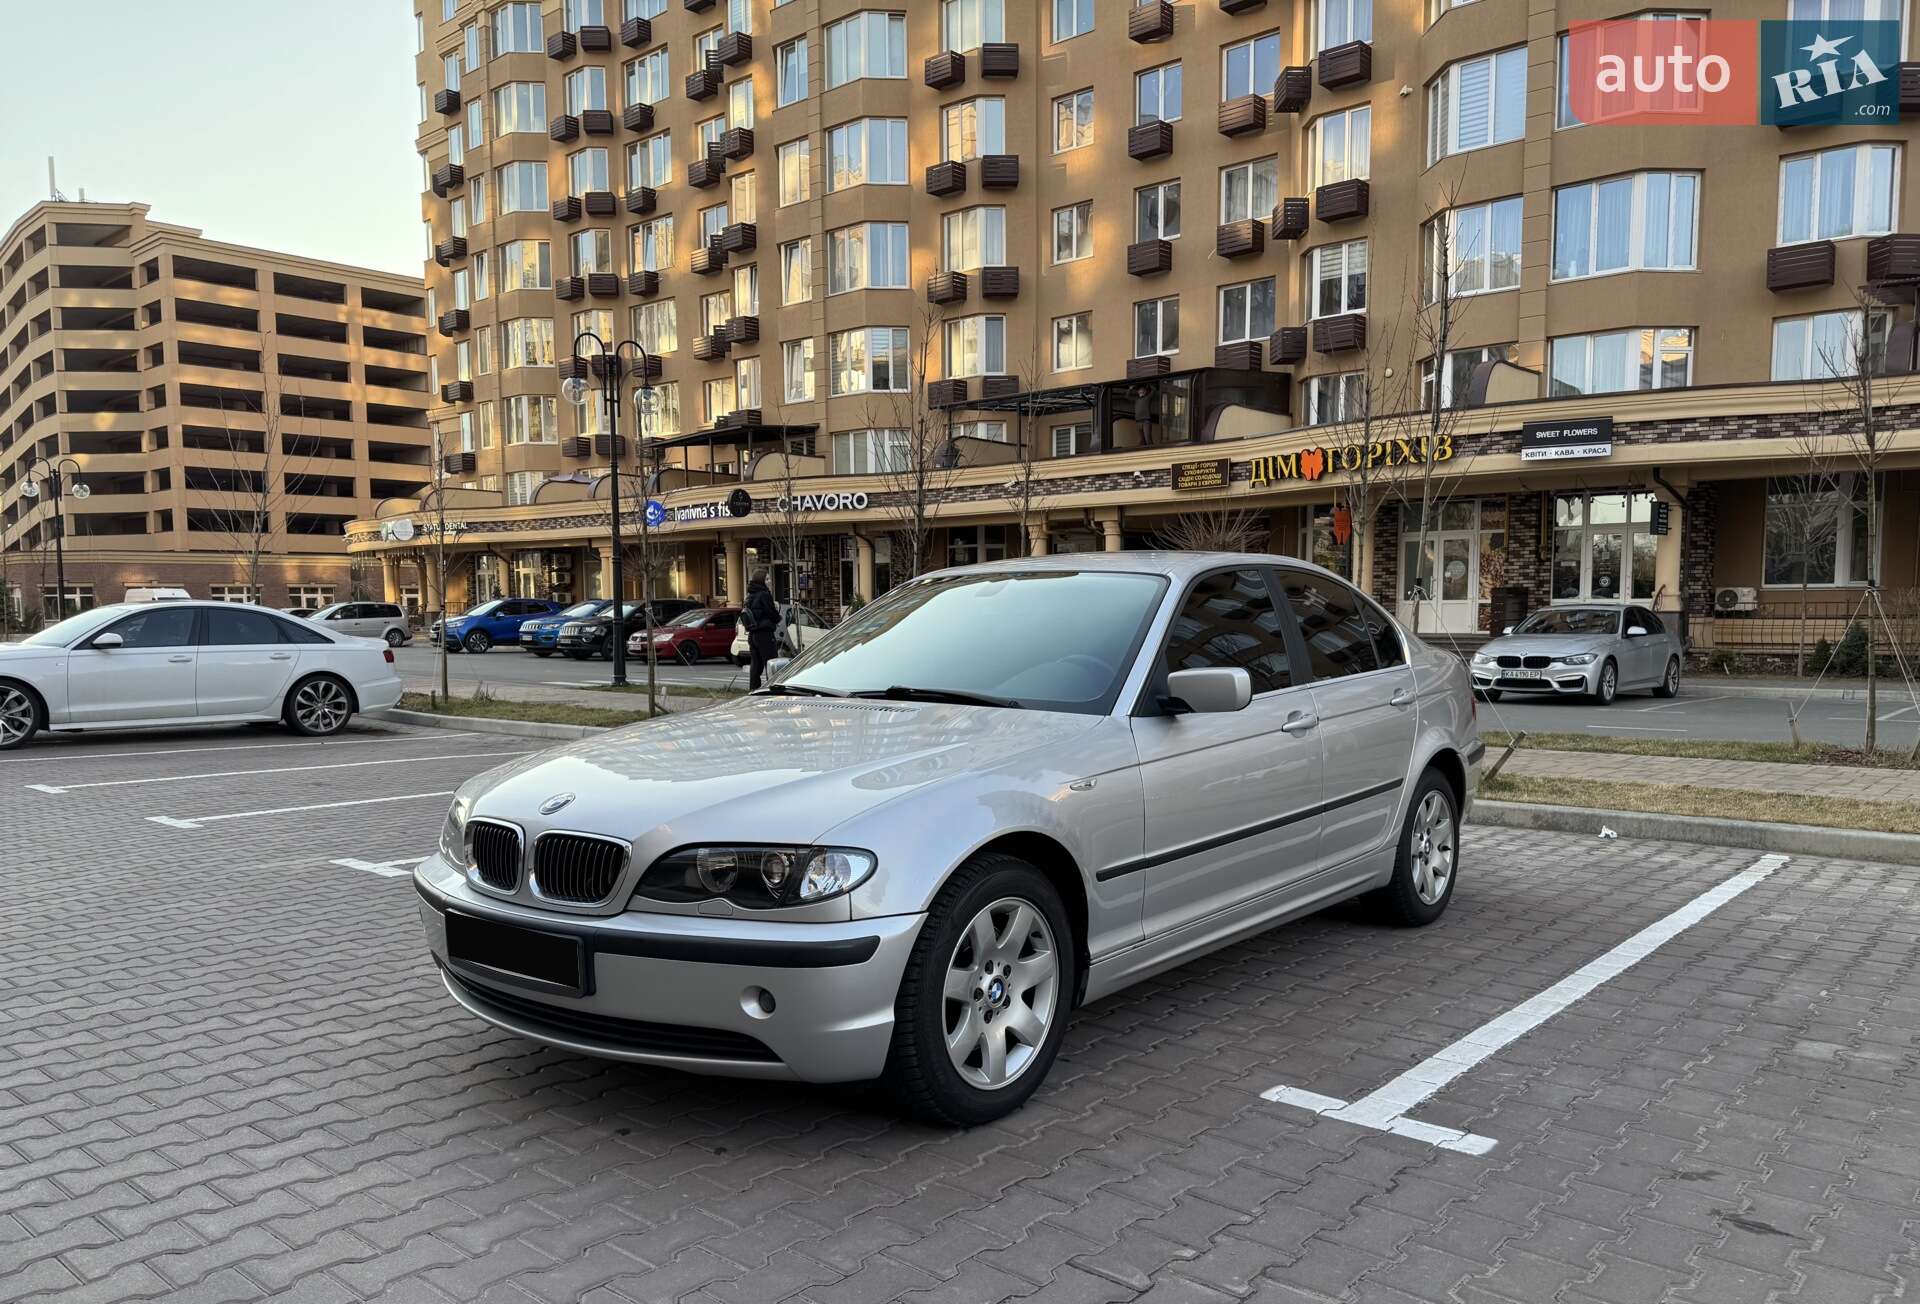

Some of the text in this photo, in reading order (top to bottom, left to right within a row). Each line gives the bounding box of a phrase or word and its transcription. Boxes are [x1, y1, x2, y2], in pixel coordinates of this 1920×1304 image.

[1535, 427, 1599, 439] SWEET FLOWERS
[1250, 434, 1455, 488] ДІМ ГОРІХІВ
[1582, 447, 1607, 455] КРАСА
[675, 500, 734, 521] Ivanivna's fis
[777, 492, 868, 512] CHAVORO
